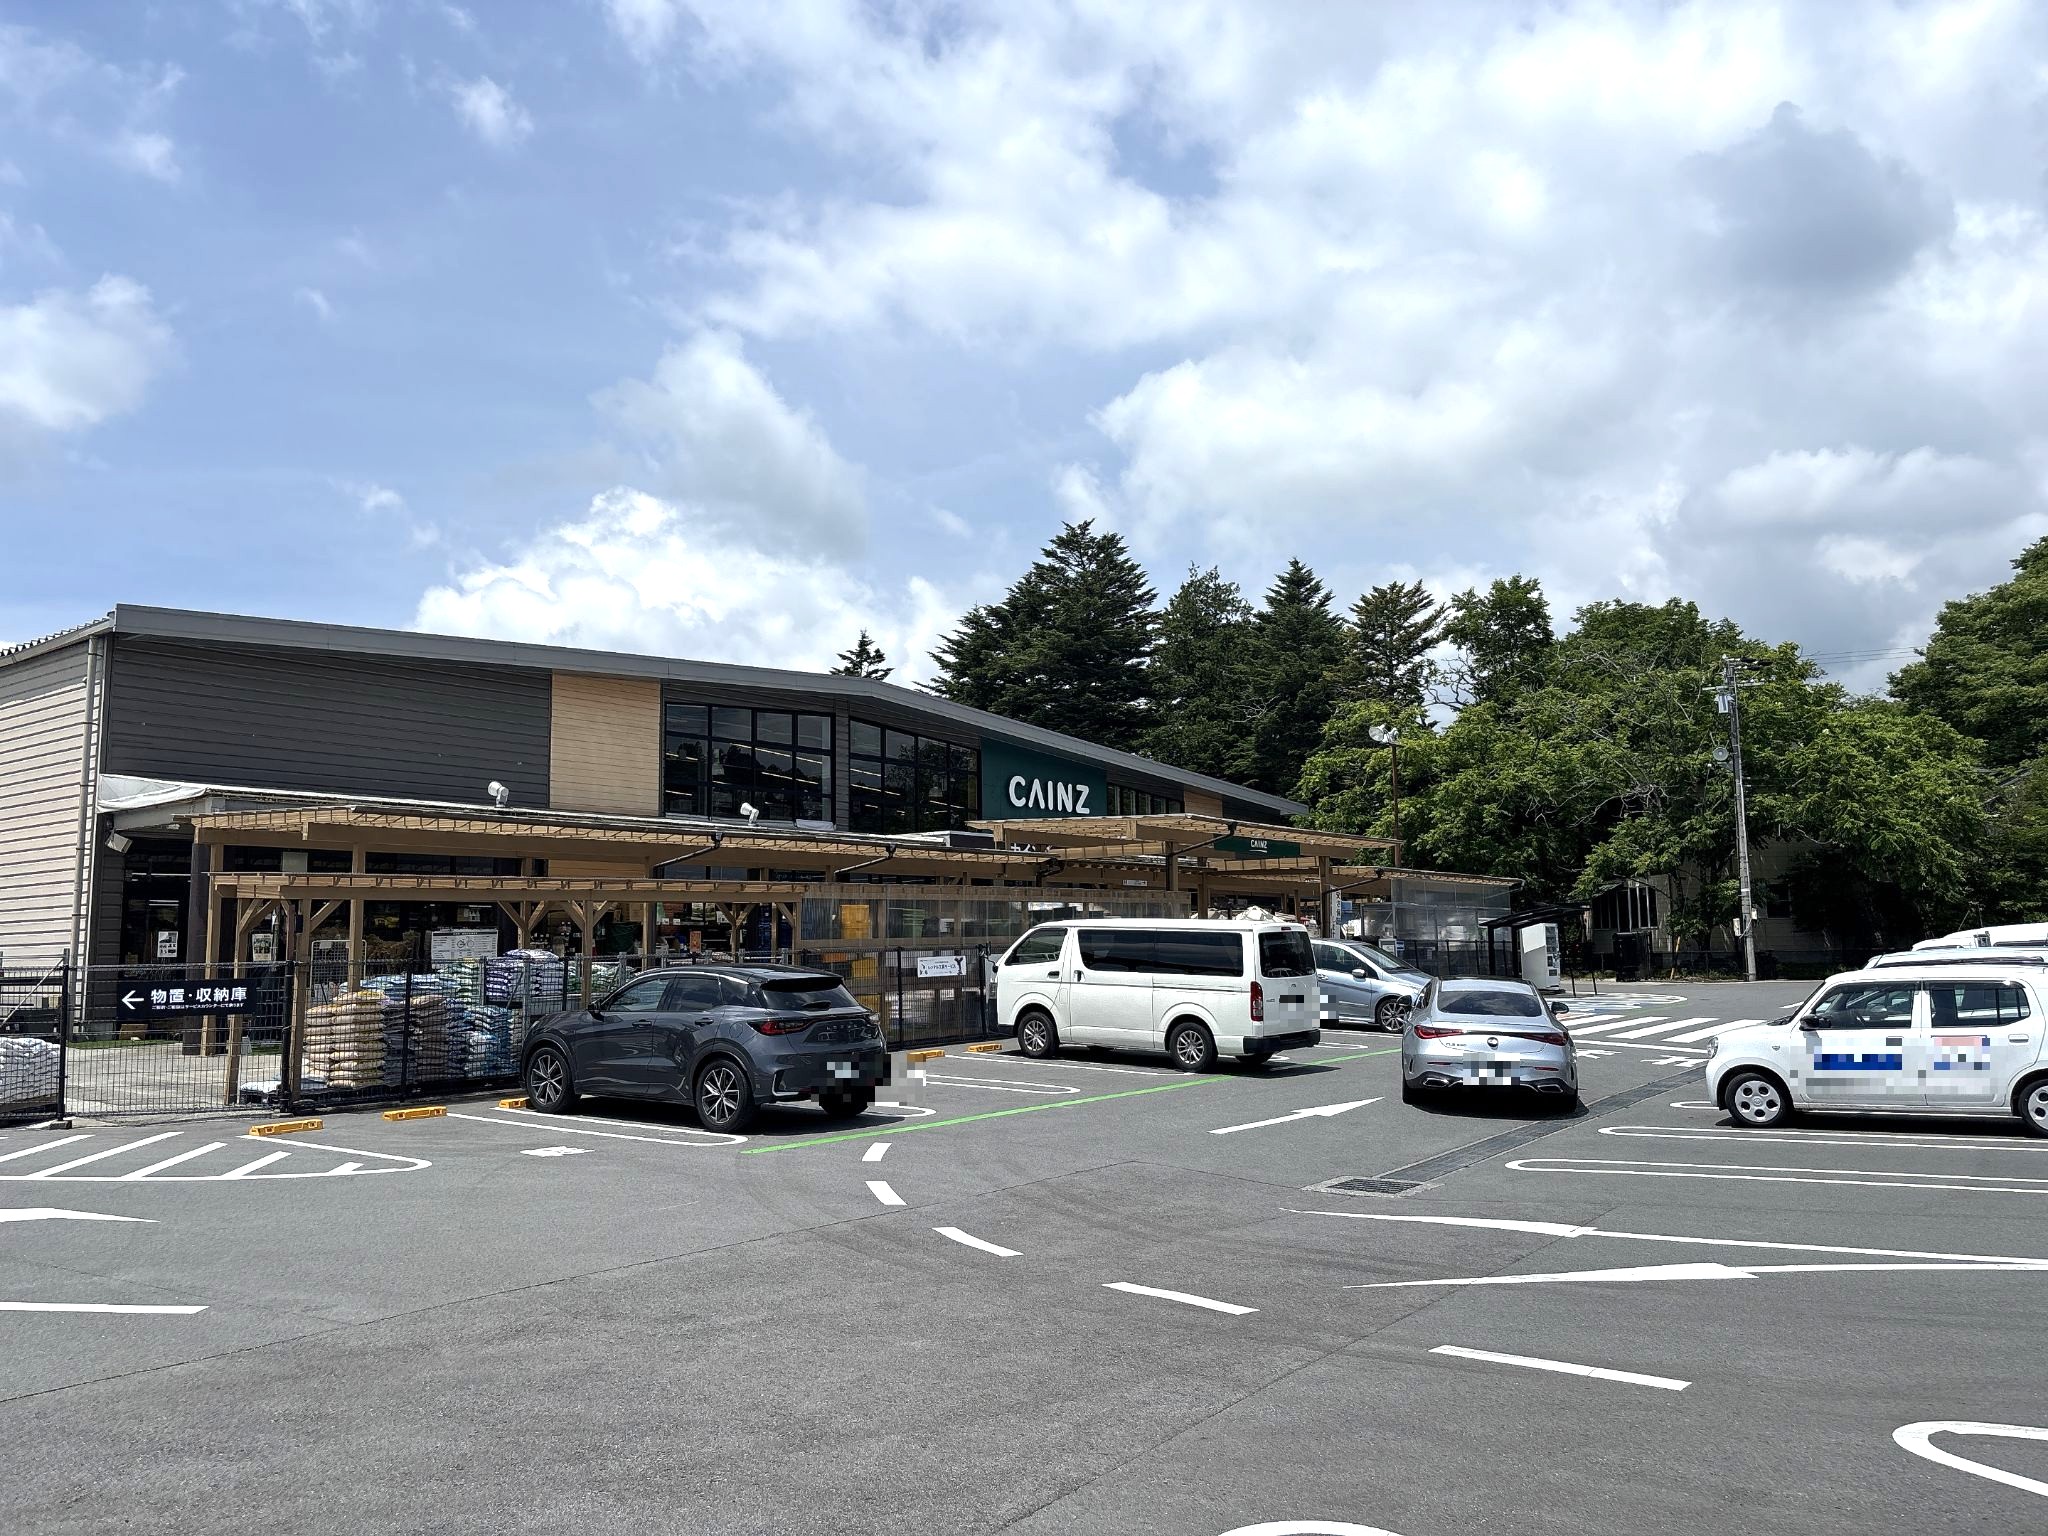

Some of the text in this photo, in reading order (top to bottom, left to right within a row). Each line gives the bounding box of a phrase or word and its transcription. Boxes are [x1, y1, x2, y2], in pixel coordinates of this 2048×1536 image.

[1008, 775, 1090, 815] CAINZ
[1250, 839, 1268, 849] CAINZ
[150, 987, 248, 1004] 物置・収納庫
